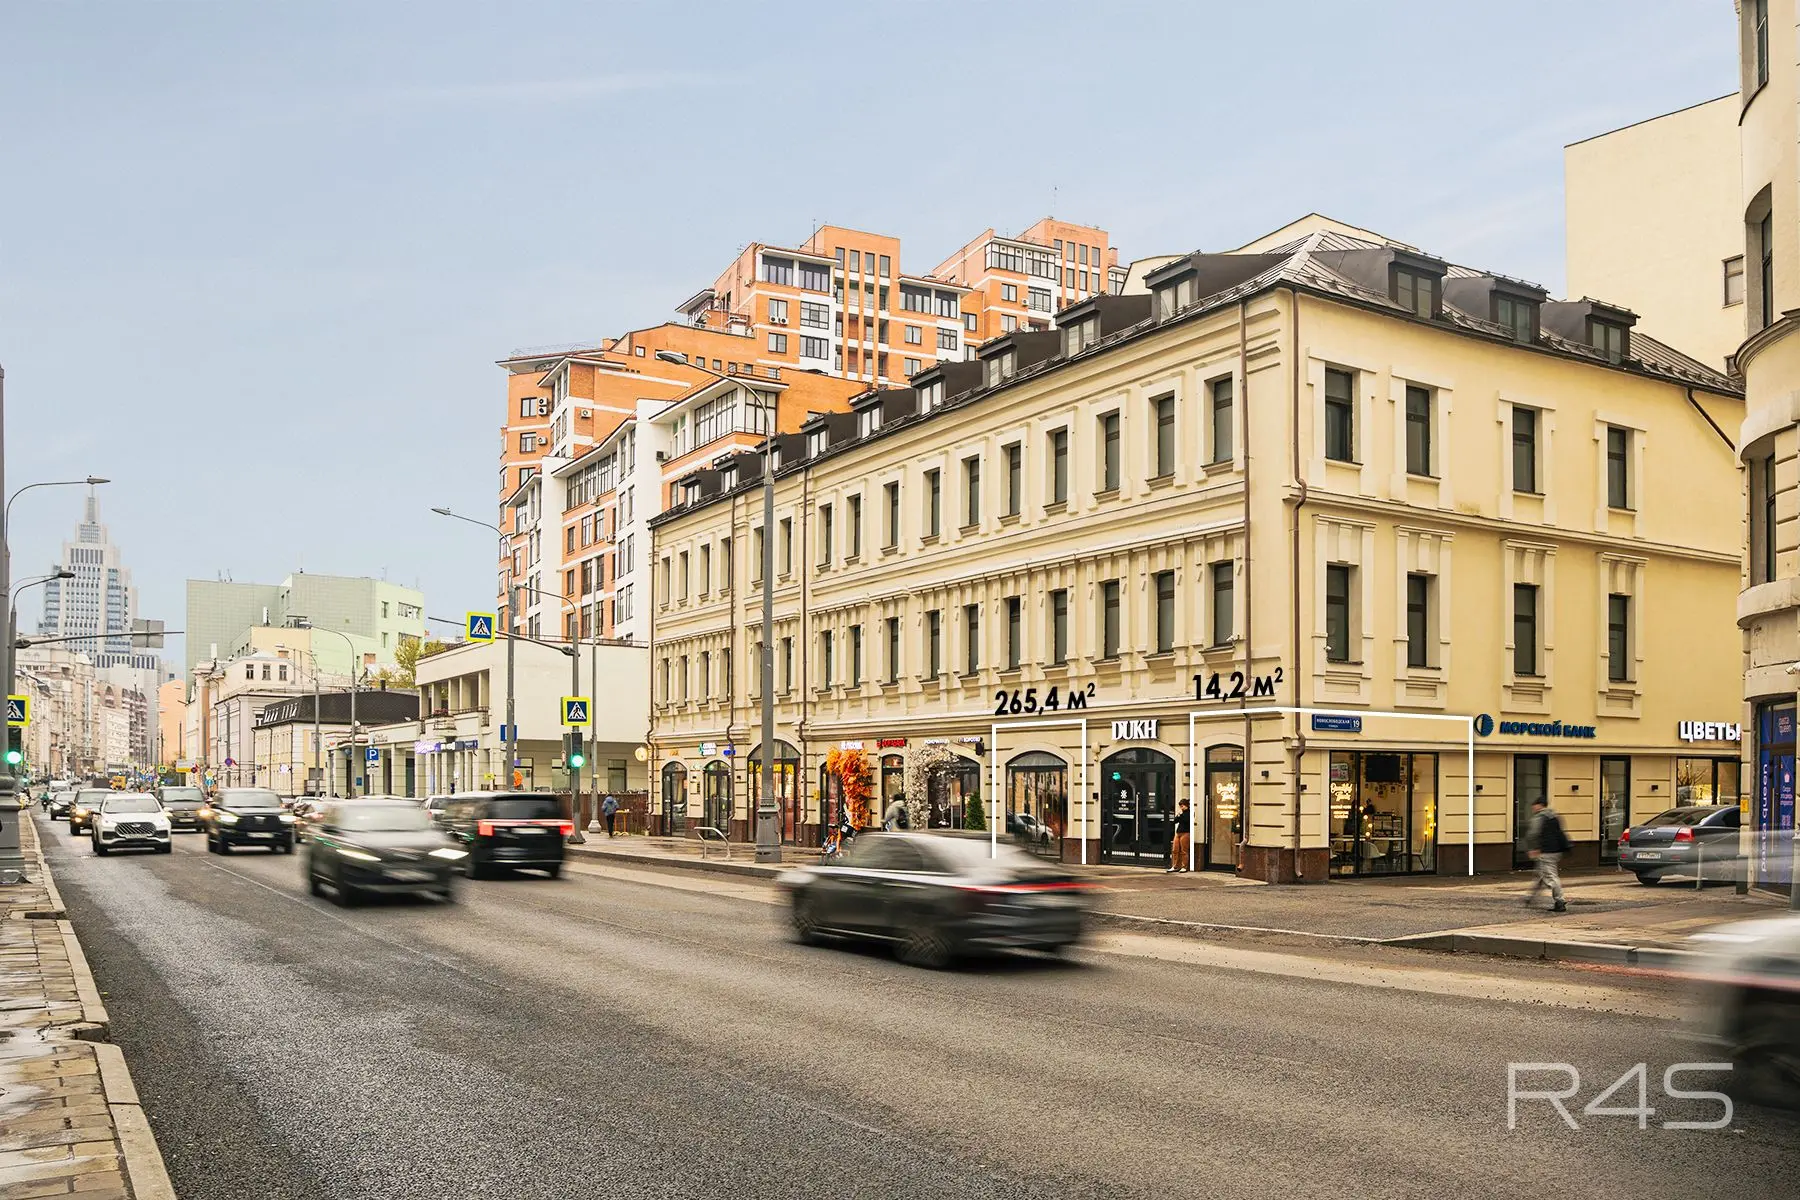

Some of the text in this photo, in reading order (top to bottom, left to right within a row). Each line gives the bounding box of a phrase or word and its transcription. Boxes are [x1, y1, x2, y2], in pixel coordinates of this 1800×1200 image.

[1111, 719, 1158, 740] DUKH
[1353, 719, 1360, 728] 19
[1500, 720, 1597, 738] МОРСКОЙ БАНК
[1679, 720, 1741, 743] ЦВЕТЫ
[369, 749, 377, 759] P
[1761, 763, 1769, 819] queen
